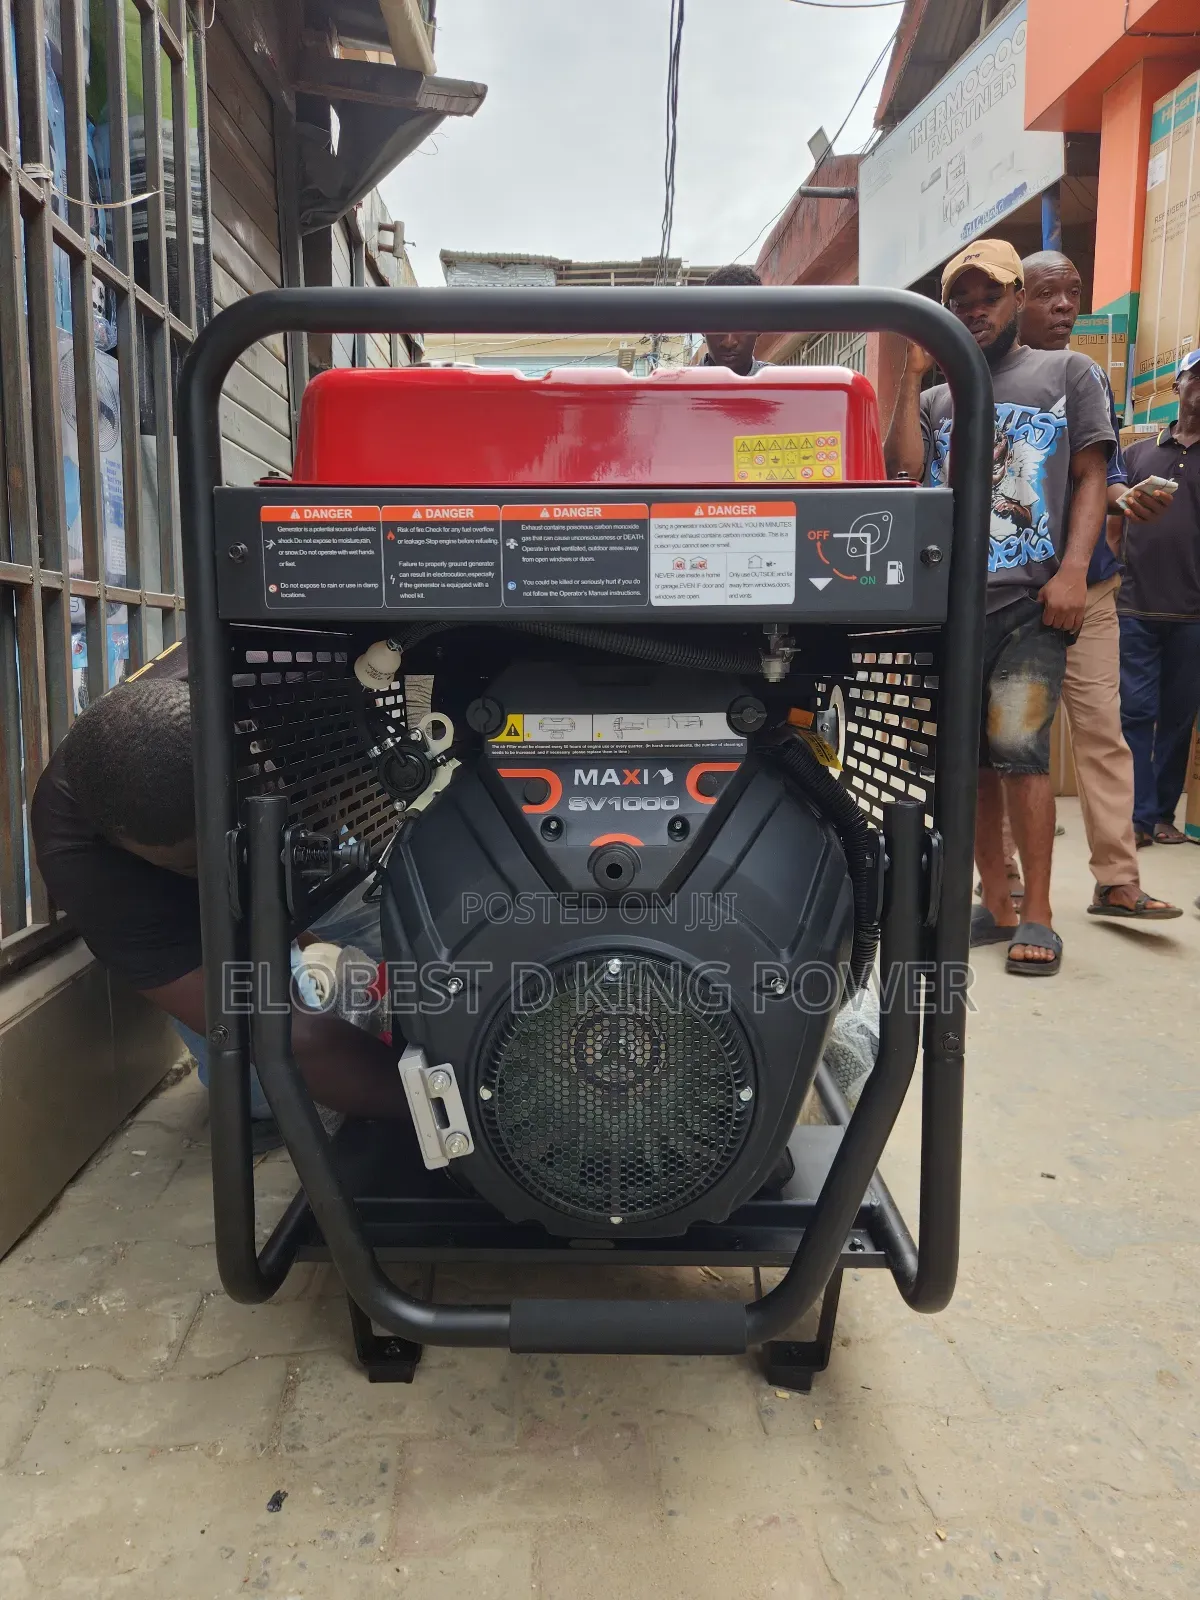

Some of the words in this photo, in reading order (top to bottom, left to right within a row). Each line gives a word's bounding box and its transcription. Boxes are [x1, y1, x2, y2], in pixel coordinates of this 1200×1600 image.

[927, 63, 1017, 163] PARTNER
[304, 509, 352, 519] DANGER
[426, 508, 474, 518] DANGER
[553, 507, 602, 517] DANGER
[708, 505, 756, 515] DANGER
[808, 530, 830, 540] OFF
[860, 576, 876, 585] ON
[574, 768, 648, 785] MAXI
[568, 796, 679, 811] SV1000
